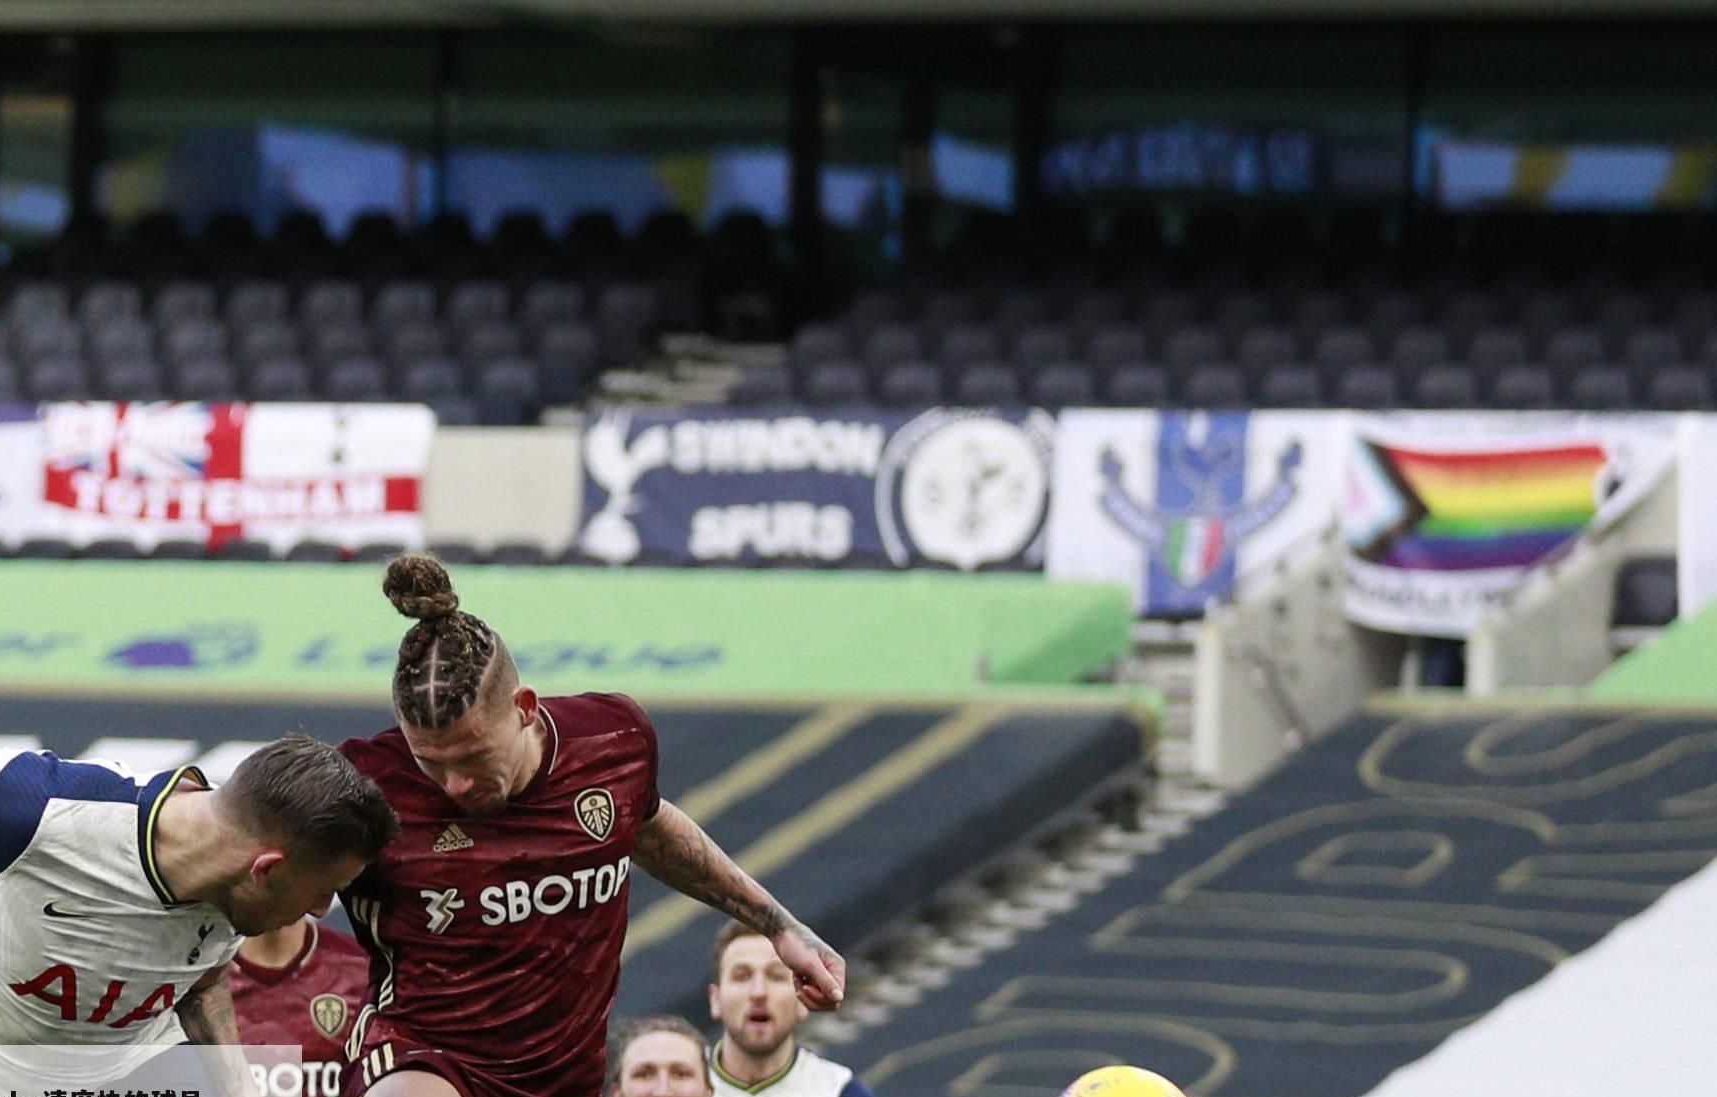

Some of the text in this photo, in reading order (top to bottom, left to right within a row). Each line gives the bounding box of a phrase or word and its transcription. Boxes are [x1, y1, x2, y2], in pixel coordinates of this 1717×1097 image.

[689, 501, 854, 561] SPURS
[479, 855, 631, 927] SBOTOP
[8, 963, 176, 1029] AIA
